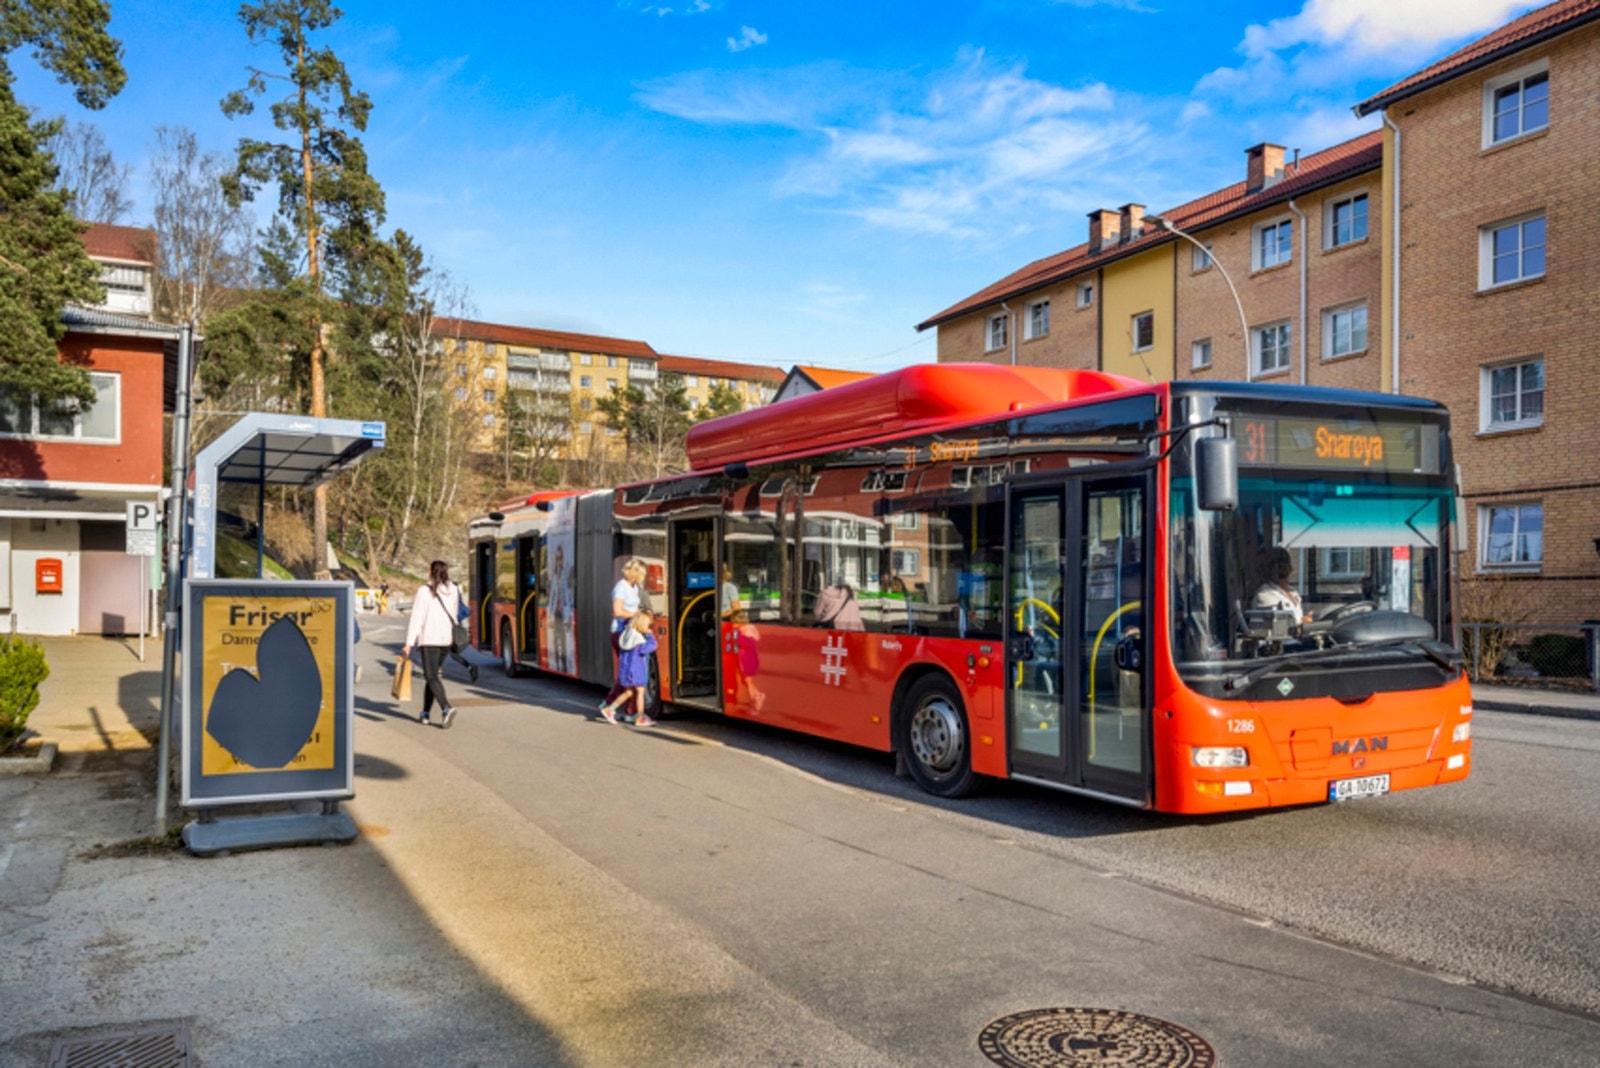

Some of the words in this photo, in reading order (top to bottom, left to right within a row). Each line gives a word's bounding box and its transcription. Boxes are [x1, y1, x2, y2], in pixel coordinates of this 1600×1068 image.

[1244, 422, 1266, 462] 31
[134, 505, 149, 527] P
[1227, 719, 1255, 733] 1286
[1332, 735, 1388, 756] MAN
[1338, 780, 1352, 796] GA
[1356, 775, 1387, 792] 10672
